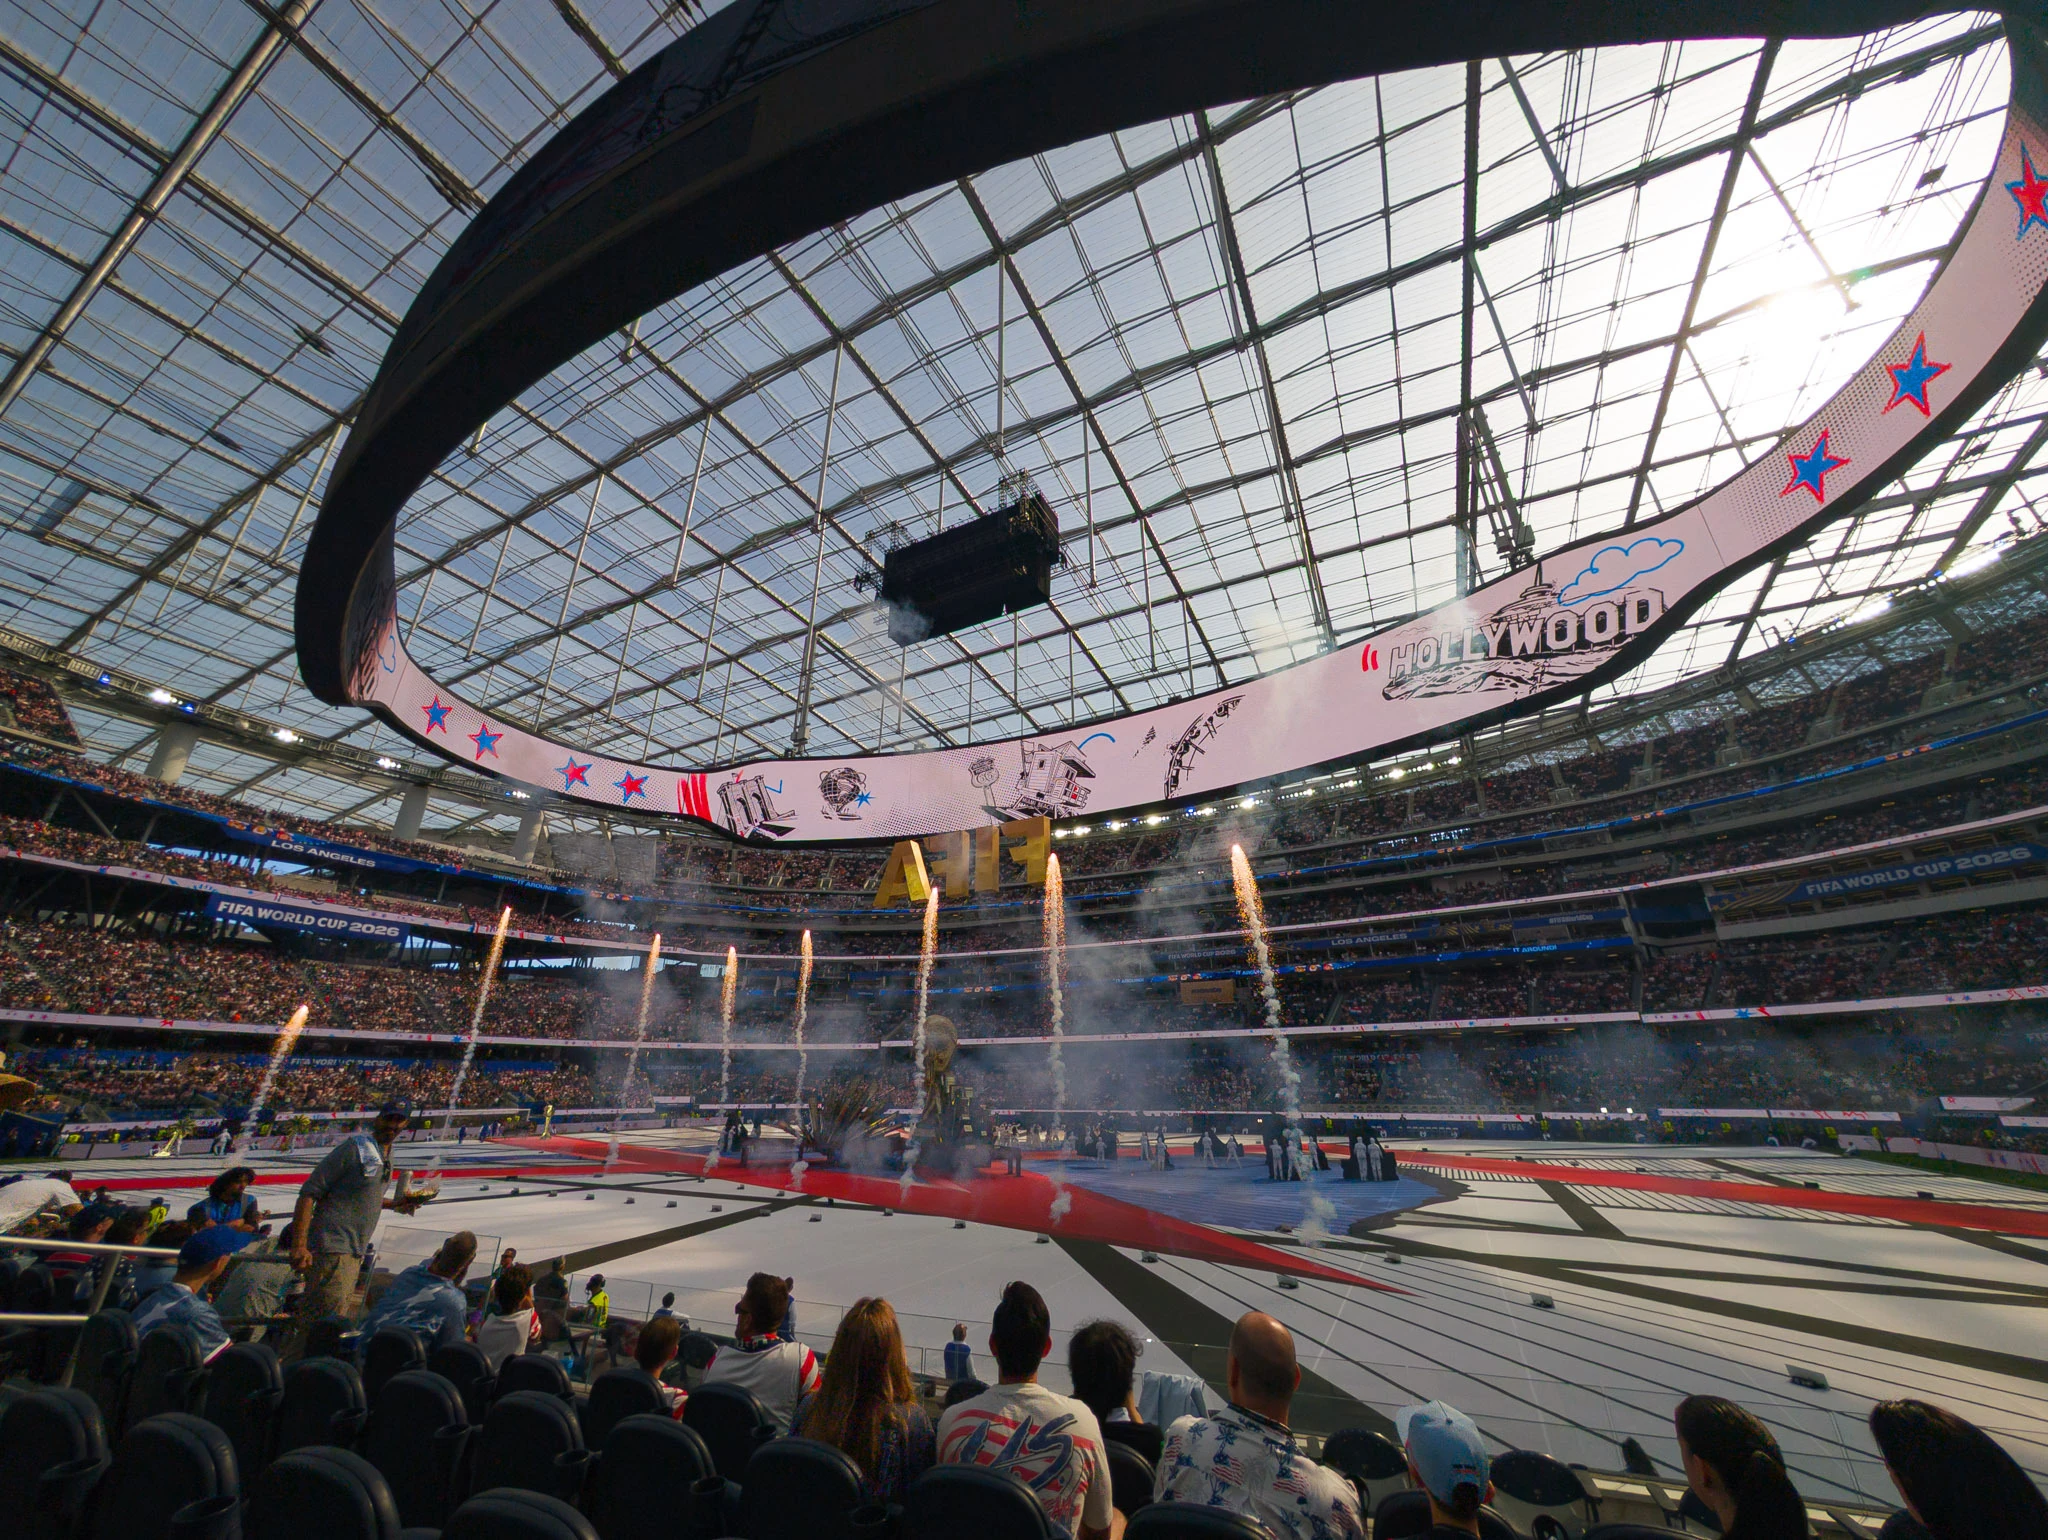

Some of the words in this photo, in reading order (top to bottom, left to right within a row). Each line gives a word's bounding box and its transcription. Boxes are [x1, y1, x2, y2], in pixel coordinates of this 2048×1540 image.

[1389, 588, 1666, 679] HOLLYWOOD
[271, 840, 304, 853] LOS
[307, 848, 376, 867] ANGELES
[1806, 881, 1846, 895] FIFA
[1843, 868, 1910, 889] WORLD
[1912, 860, 1953, 877] CUP
[1954, 847, 2032, 870] 2026
[217, 901, 254, 917] FIFA
[257, 907, 315, 926] WORLD
[317, 917, 348, 930] CUP
[349, 922, 400, 937] 2026
[1331, 938, 1355, 946] LOS
[1355, 933, 1408, 944] ANGELES
[1502, 1123, 1525, 1131] FIFA
